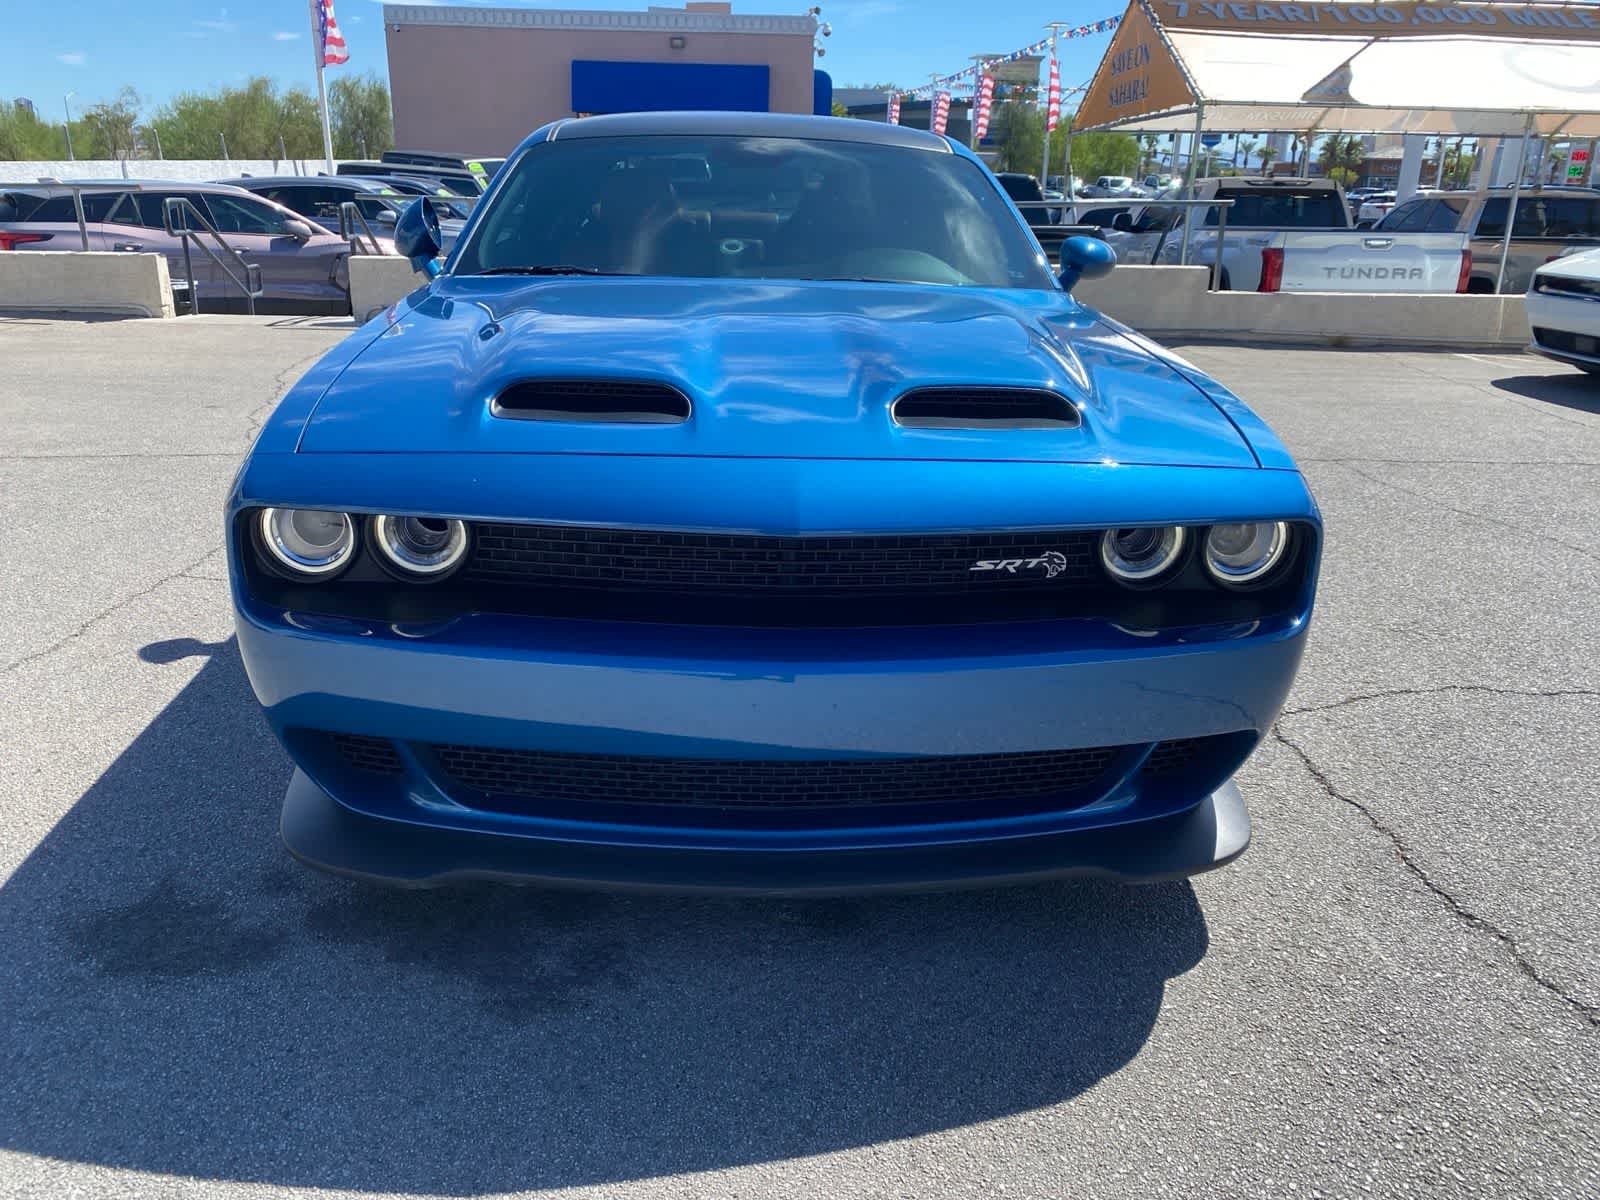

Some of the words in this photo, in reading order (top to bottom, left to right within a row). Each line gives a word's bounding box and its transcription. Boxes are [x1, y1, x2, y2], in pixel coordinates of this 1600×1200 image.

[1111, 47, 1135, 77] SAVE
[1134, 42, 1150, 68] ON
[1322, 266, 1424, 280] TUNDRA
[968, 558, 1048, 573] SRT
